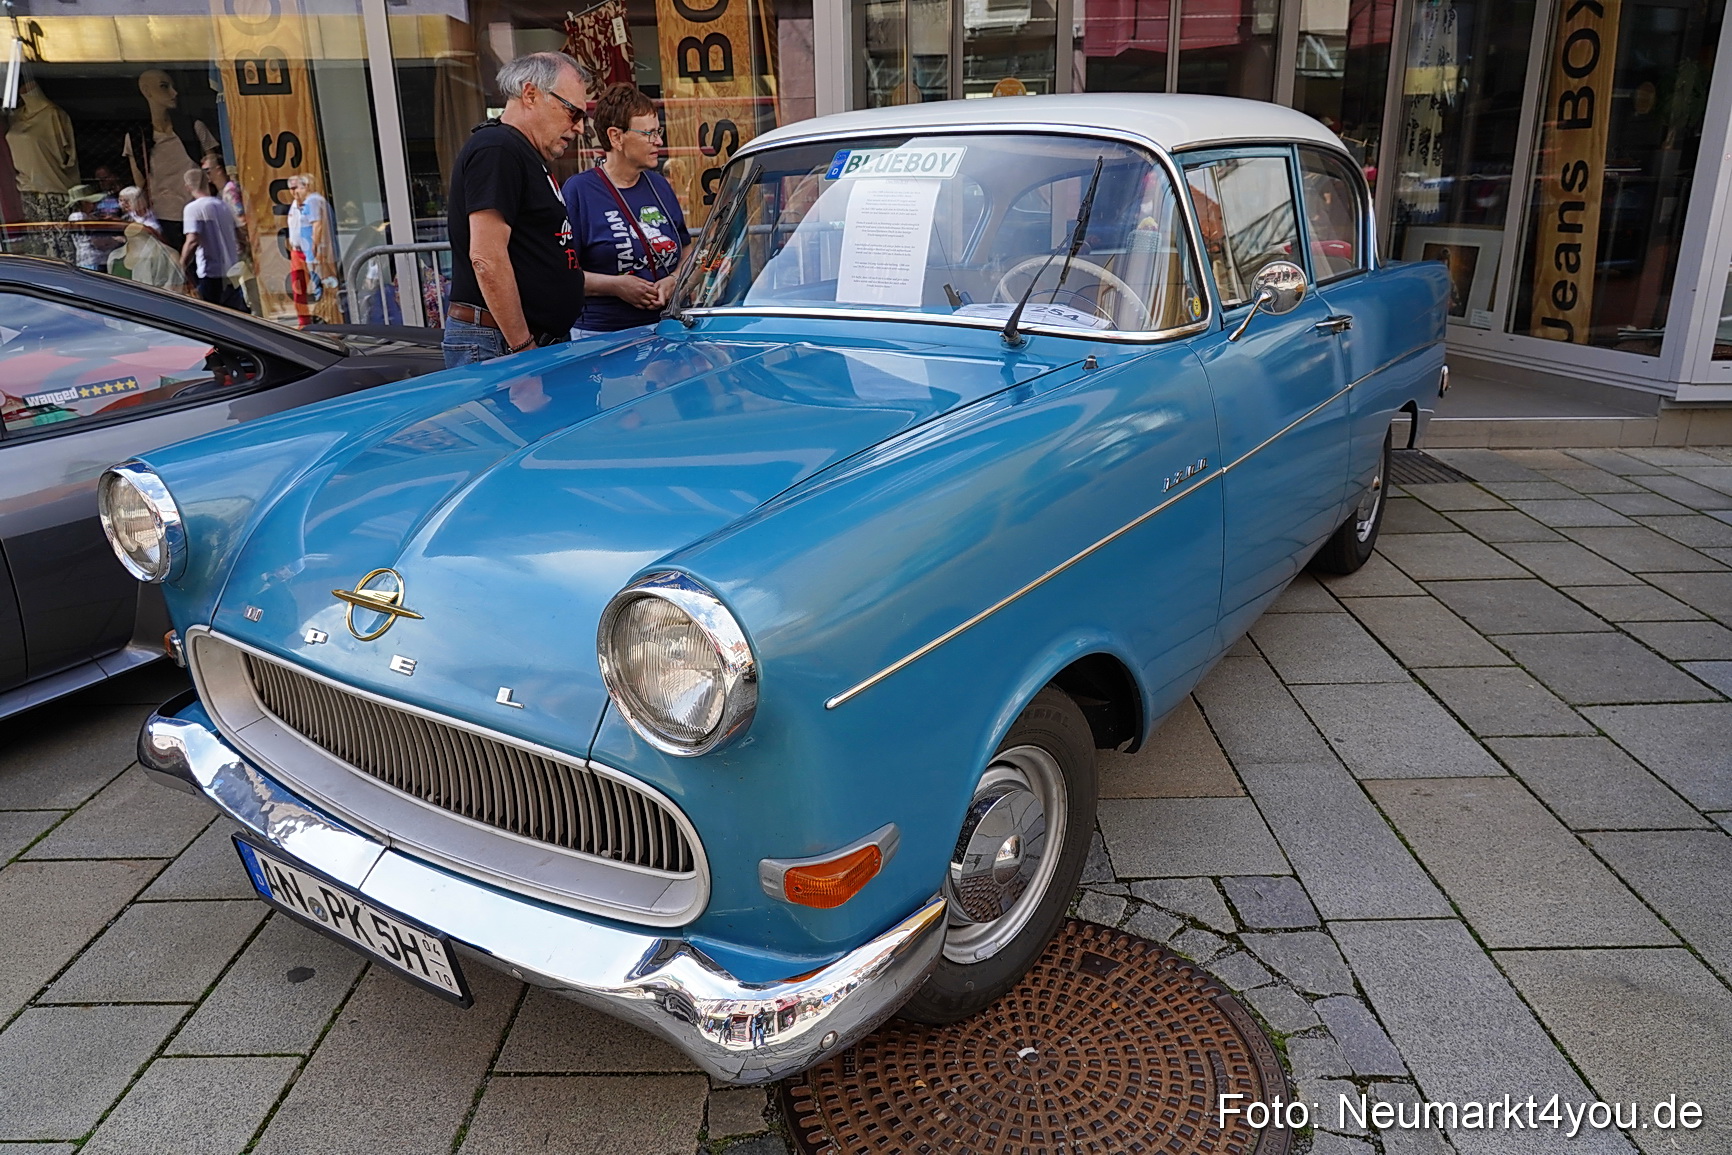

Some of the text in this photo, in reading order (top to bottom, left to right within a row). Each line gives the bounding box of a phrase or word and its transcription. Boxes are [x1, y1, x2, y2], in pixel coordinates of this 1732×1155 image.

[844, 152, 957, 174] BLUEBOY
[1540, 160, 1590, 343] Jeans
[260, 857, 431, 977] AN PK 5H
[434, 968, 453, 987] 10
